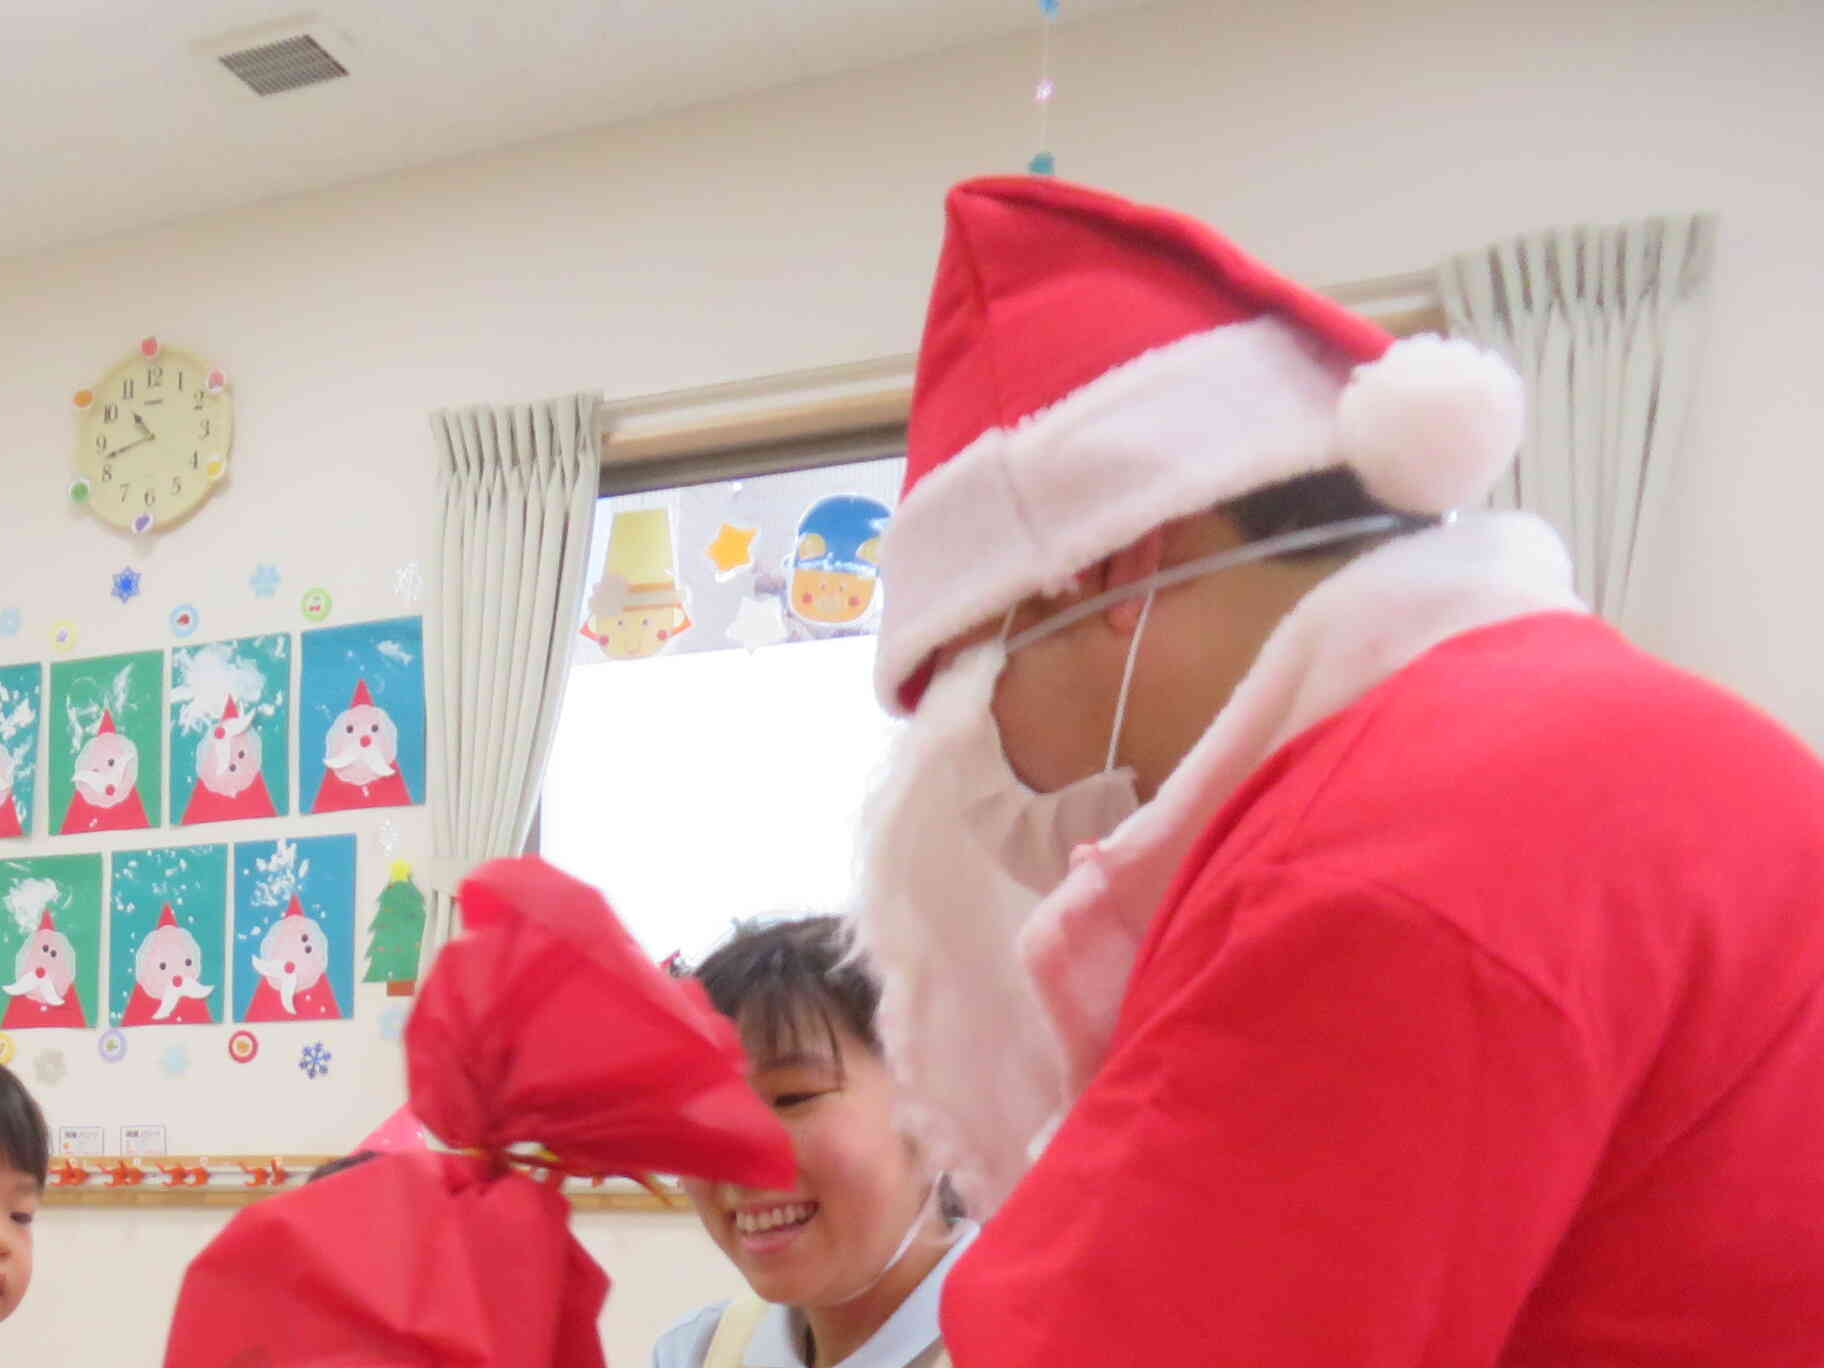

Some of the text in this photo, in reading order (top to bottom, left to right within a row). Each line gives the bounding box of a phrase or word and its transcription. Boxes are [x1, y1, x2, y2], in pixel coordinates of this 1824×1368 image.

[146, 367, 164, 389] 12
[122, 378, 135, 400] 11
[193, 391, 206, 411] 2
[103, 403, 119, 424] 10
[95, 432, 107, 453] 9
[189, 450, 199, 470] 4
[101, 464, 113, 482] 8
[119, 483, 129, 503] 7
[171, 476, 182, 496] 5
[143, 489, 156, 507] 6
